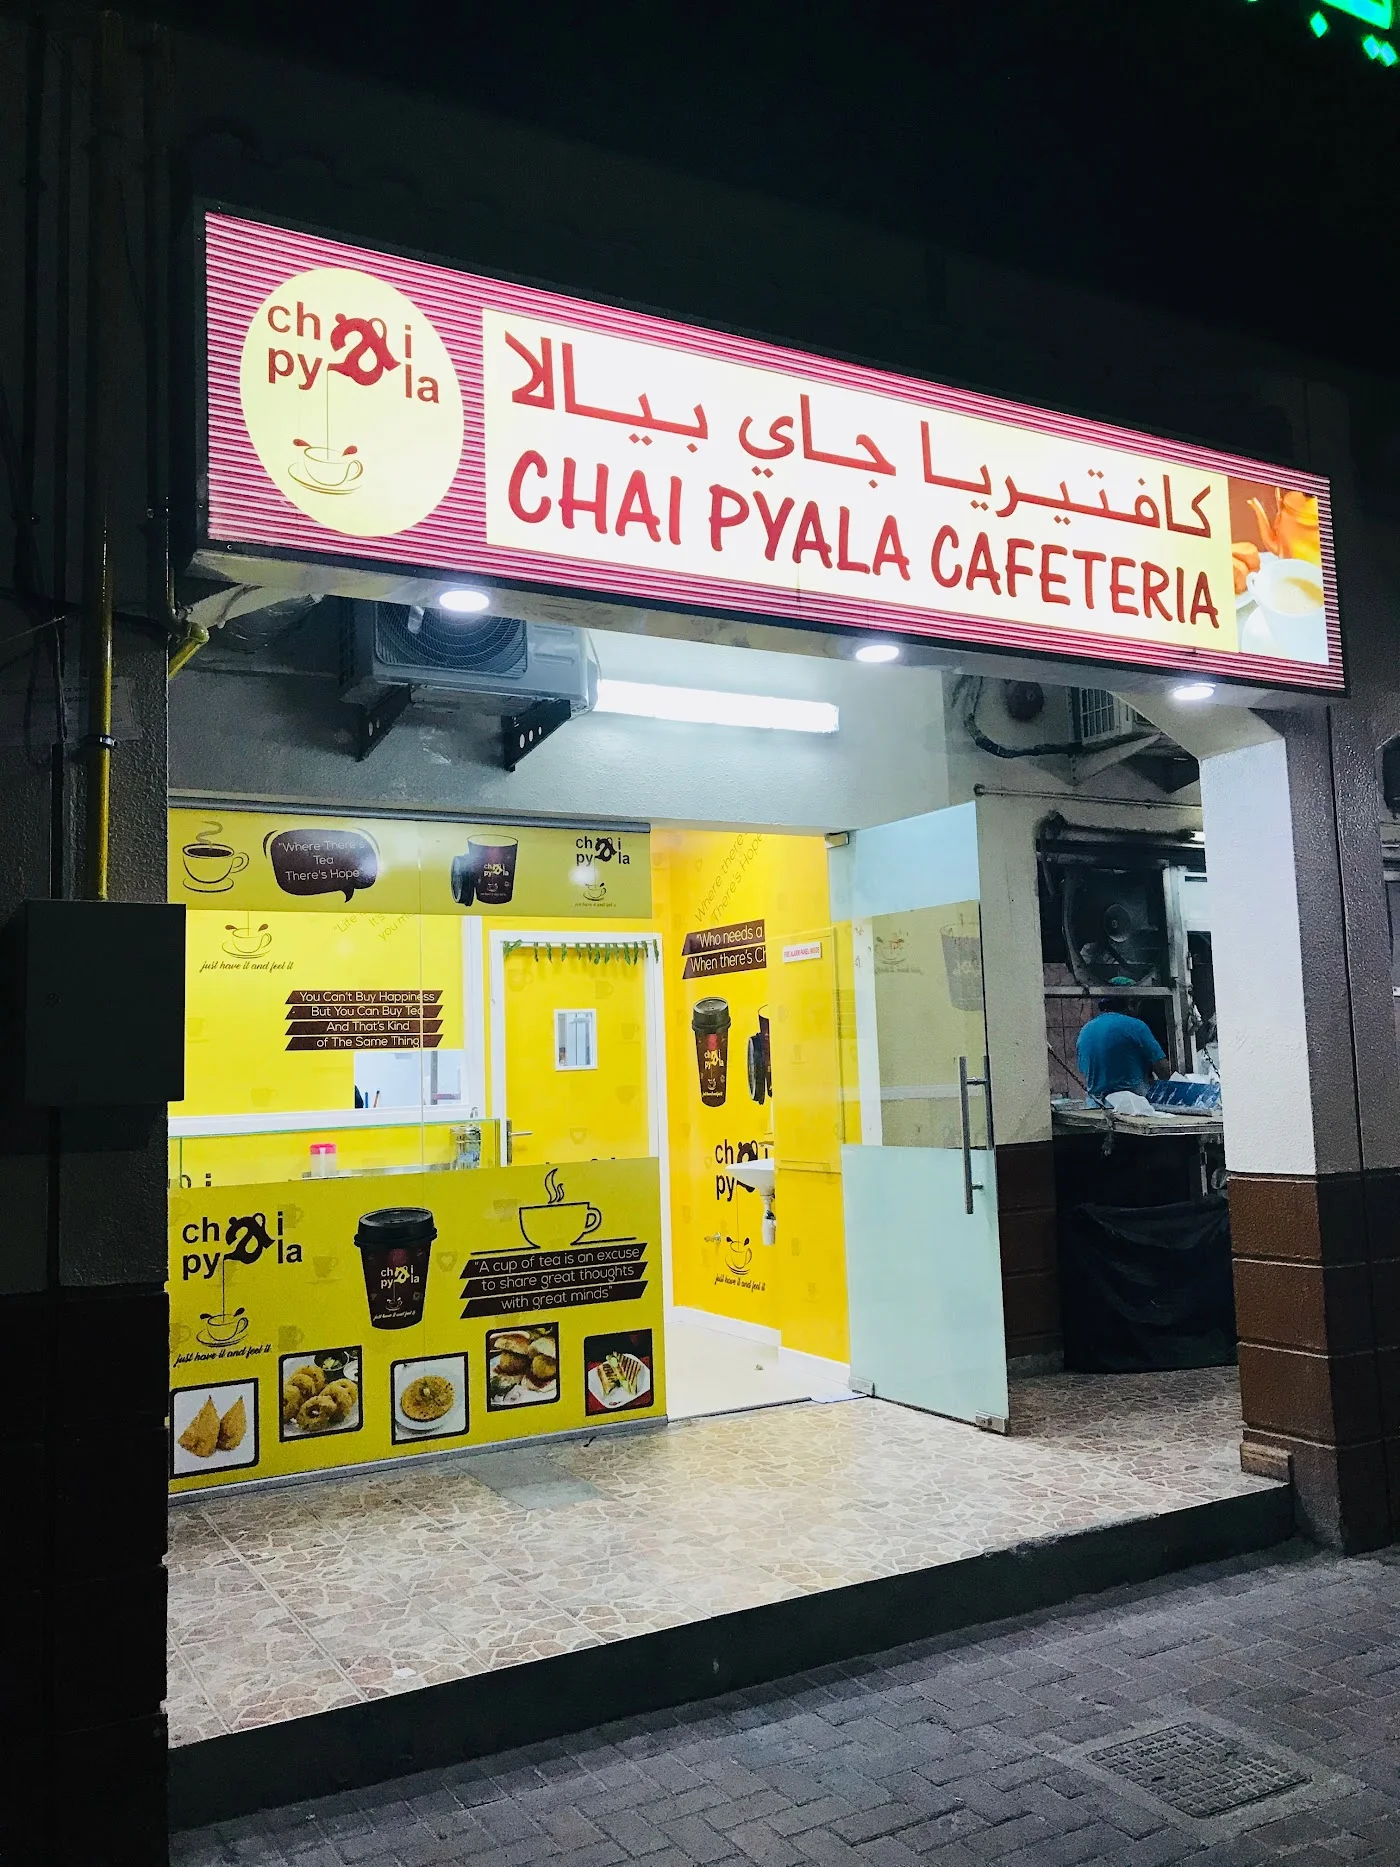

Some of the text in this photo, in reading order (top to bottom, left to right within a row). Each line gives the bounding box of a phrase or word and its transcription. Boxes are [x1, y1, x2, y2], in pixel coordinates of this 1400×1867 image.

[738, 394, 896, 488] جاي
[920, 420, 1211, 538] كافتيريا
[508, 450, 1220, 628] CHAI PYALA CAFETERIA
[324, 840, 366, 850] There's
[313, 855, 334, 865] Tea
[285, 870, 327, 881] There's
[694, 875, 722, 922] Where
[710, 871, 742, 923] There's
[723, 925, 753, 944] needs
[755, 926, 763, 938] a
[220, 961, 240, 970] have
[251, 961, 270, 970] and
[269, 961, 285, 973] feel
[690, 957, 717, 972] When
[719, 949, 753, 968] there's
[299, 991, 435, 1004] You Can't Buy Happiness
[311, 1005, 424, 1018] But You Can Buy Tea
[326, 1020, 410, 1032] And That's Kind
[316, 1036, 420, 1048] of The Same Thing
[474, 1248, 640, 1273] "A cup of tea is an excuse
[481, 1265, 635, 1291] to share great thoughts
[501, 1285, 613, 1310] with great minds"
[194, 1352, 217, 1361] have
[227, 1346, 247, 1357] and
[246, 1345, 262, 1359] feel
